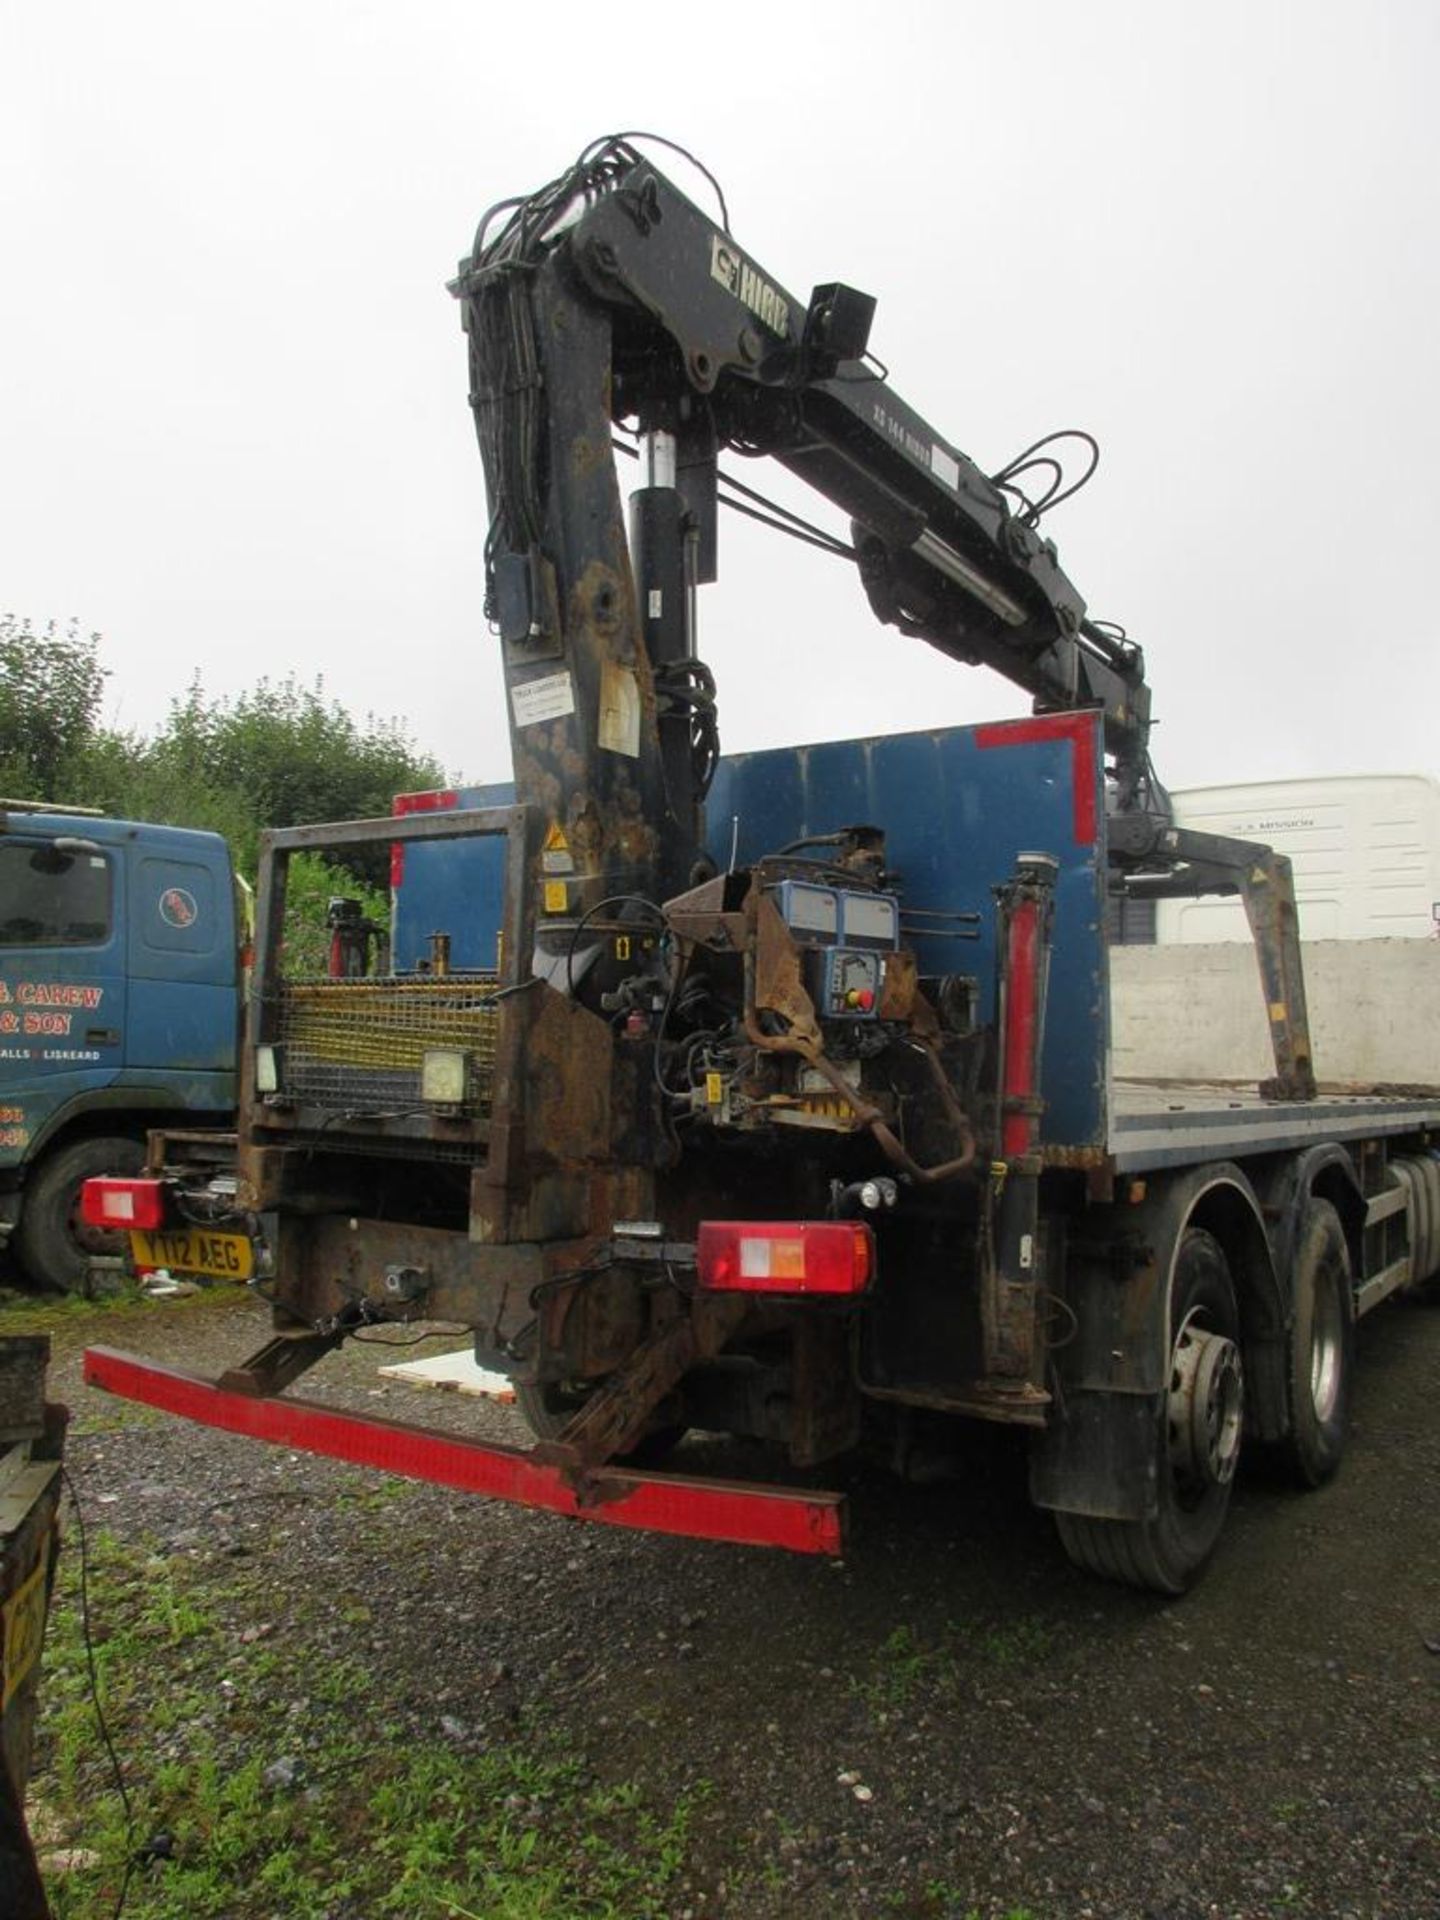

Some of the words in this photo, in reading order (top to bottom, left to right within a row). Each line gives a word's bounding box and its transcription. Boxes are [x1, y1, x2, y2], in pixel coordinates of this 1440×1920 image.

[16, 983, 103, 1008] CAREW
[24, 1012, 72, 1035] SON
[43, 1049, 101, 1061] LISKEARD
[199, 1237, 240, 1271] AEG
